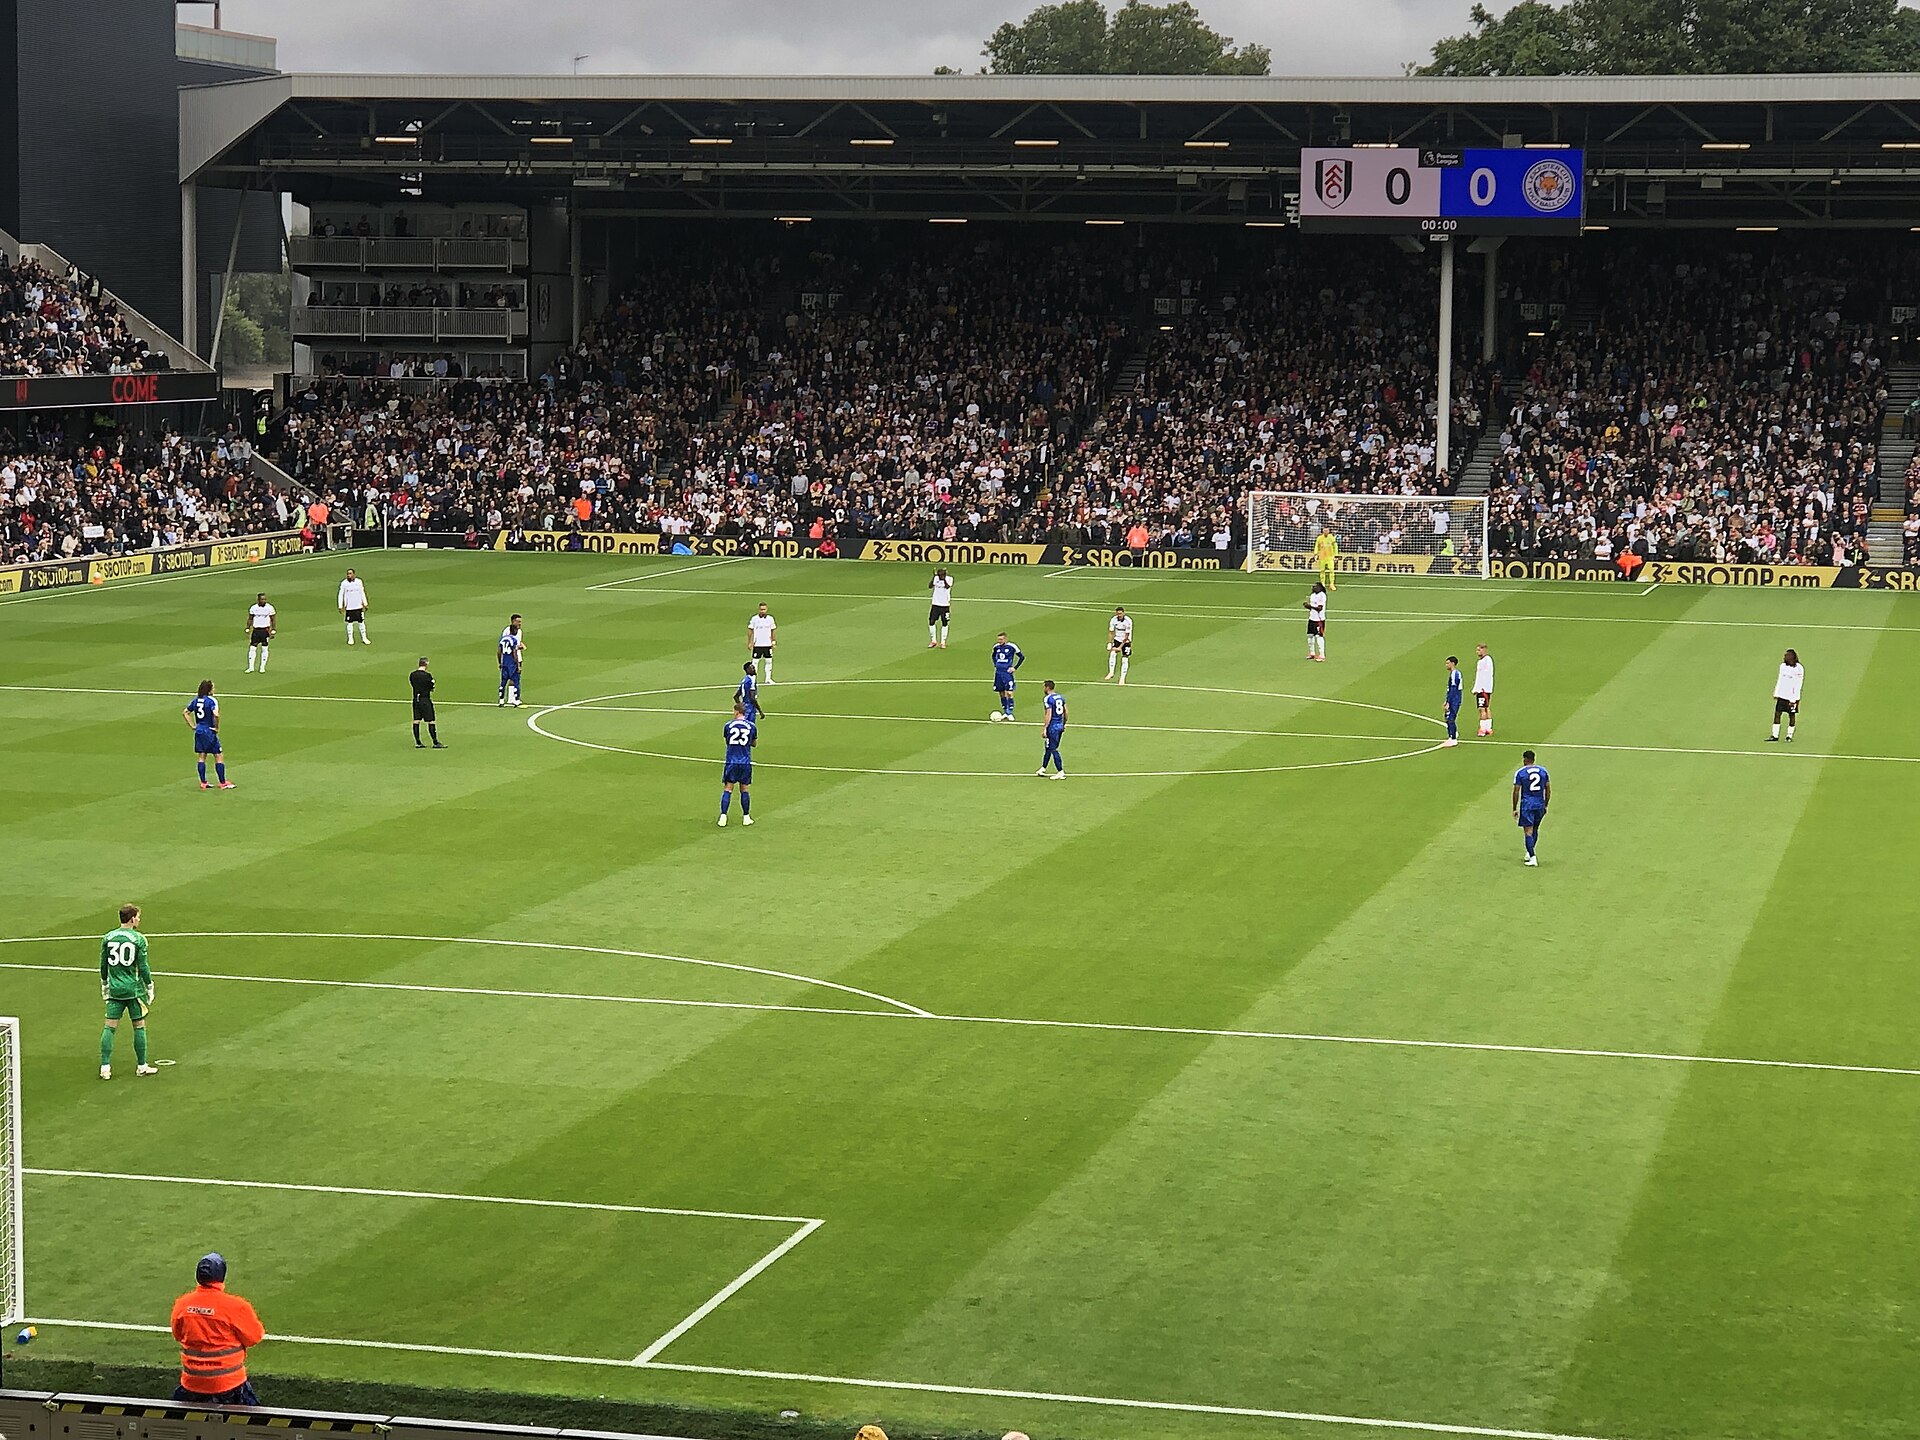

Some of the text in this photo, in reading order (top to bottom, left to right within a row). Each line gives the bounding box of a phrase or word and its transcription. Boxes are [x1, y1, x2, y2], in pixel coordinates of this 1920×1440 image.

[1528, 163, 1571, 183] LEICESTER CITY
[1385, 167, 1411, 205] 0
[1469, 167, 1497, 206] 0
[1421, 219, 1457, 232] 00:00
[111, 376, 158, 403] COME
[166, 551, 206, 570] SBOTOP.com
[897, 544, 1028, 564] SBOTOPcom
[1086, 549, 1220, 570] SBOTOPcom
[37, 567, 83, 587] SBOTOP.com
[104, 560, 146, 579] SBOTOP.com
[1677, 566, 1820, 586] SBOTOPcom
[196, 702, 205, 719] 3
[1055, 699, 1065, 715] 8
[729, 727, 751, 746] 23
[1529, 773, 1541, 791] 2
[107, 941, 136, 967] 30
